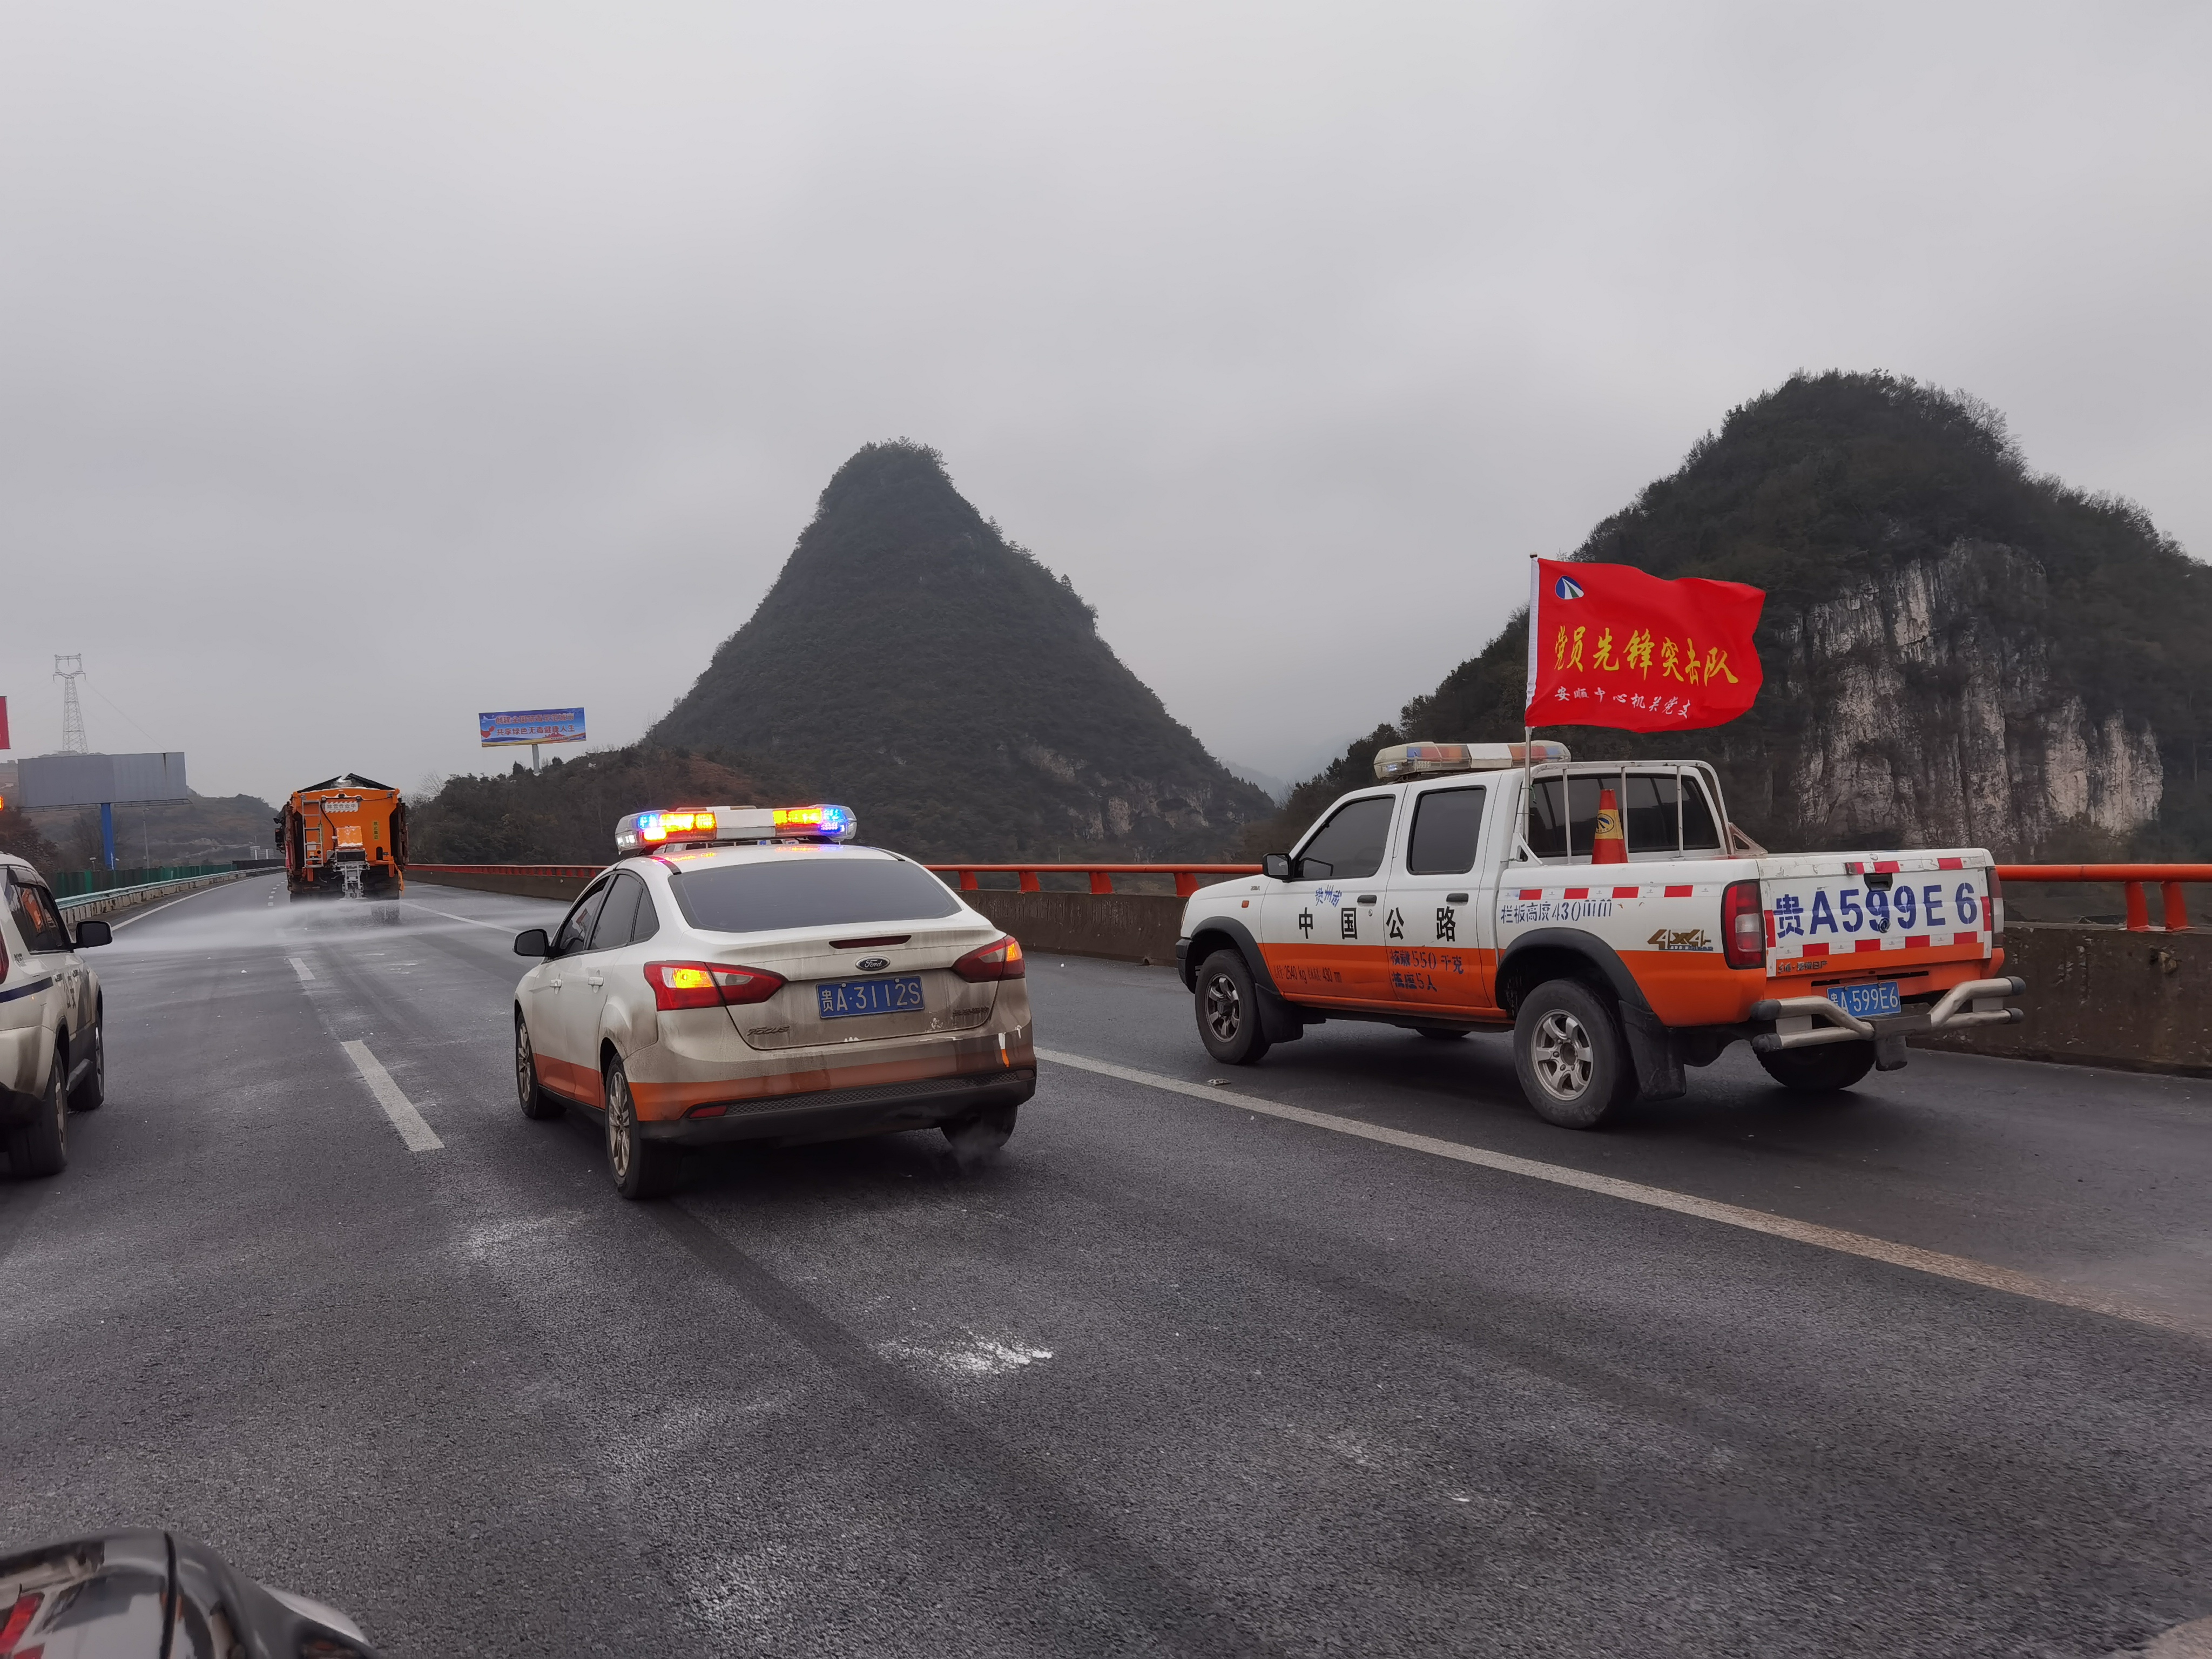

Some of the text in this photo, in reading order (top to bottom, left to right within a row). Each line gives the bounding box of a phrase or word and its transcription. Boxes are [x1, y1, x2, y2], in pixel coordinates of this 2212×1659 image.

[1554, 625, 1738, 686] 党员先锋突击队
[496, 725, 575, 736] 共享绿色无毒健康人生
[1298, 907, 1456, 942] 中国公路
[865, 959, 883, 969] Ford
